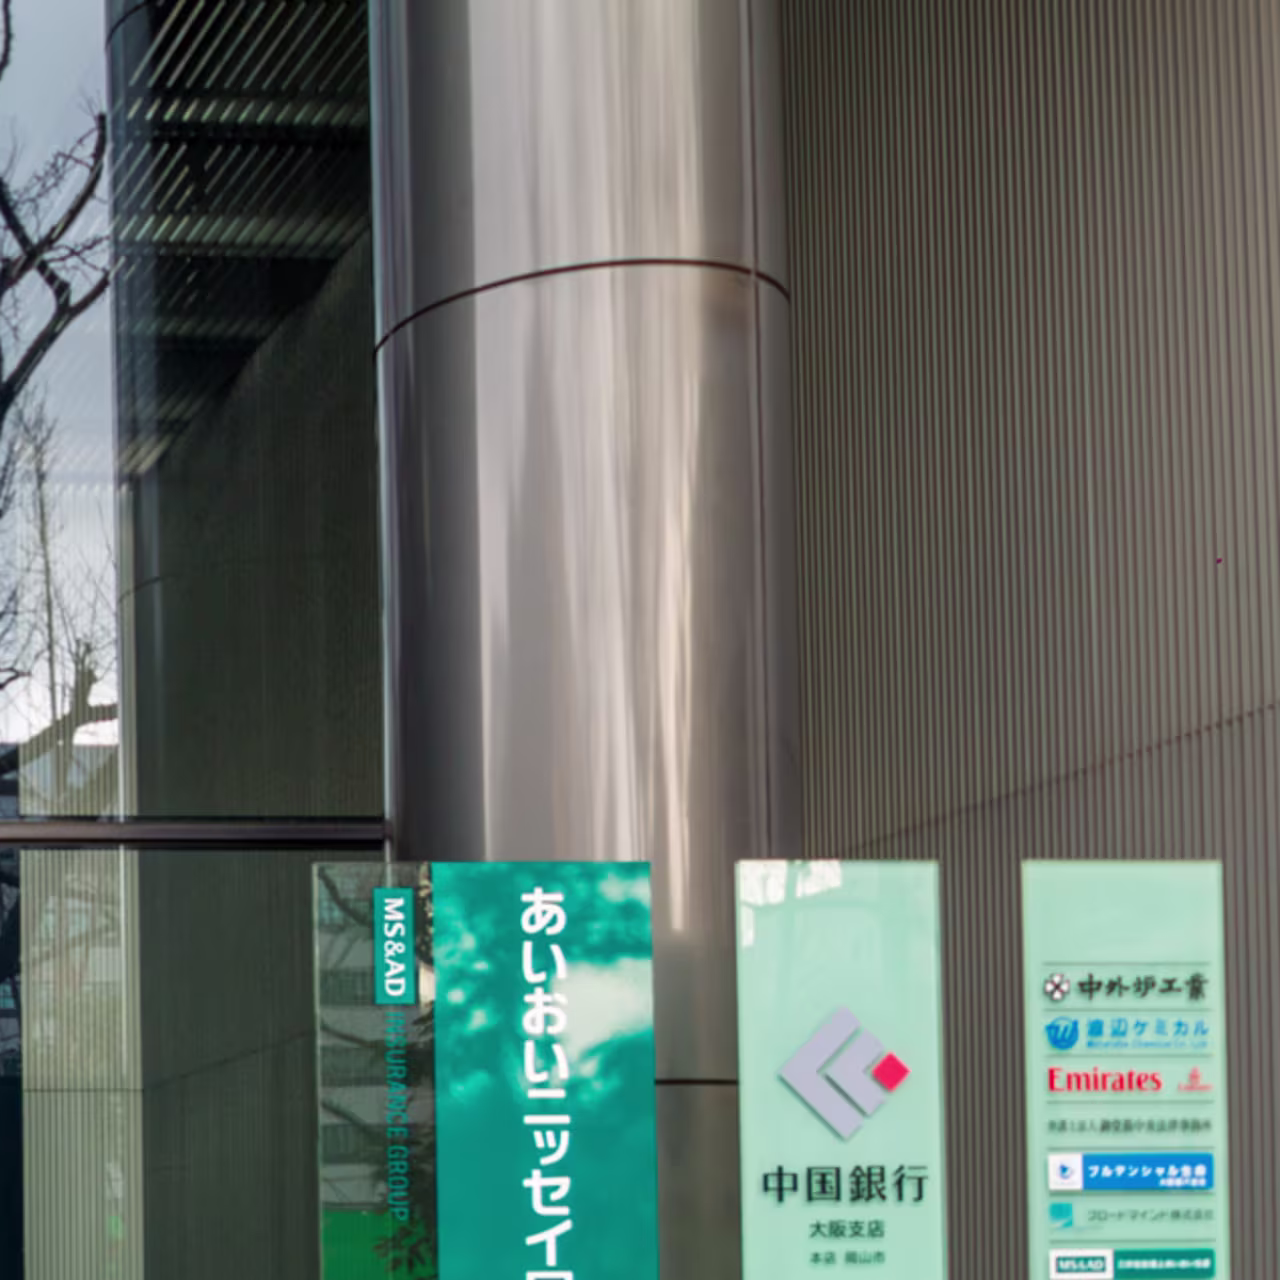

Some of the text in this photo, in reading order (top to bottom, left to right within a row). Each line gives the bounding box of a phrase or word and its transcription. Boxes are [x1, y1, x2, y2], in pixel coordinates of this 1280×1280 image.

[383, 897, 410, 1223] MS&AD INSURANCE GROUP
[1048, 1065, 1162, 1093] Emirates
[762, 1165, 929, 1203] 中国銀行
[809, 1219, 885, 1239] 大阪支店
[810, 1251, 836, 1265] 本店
